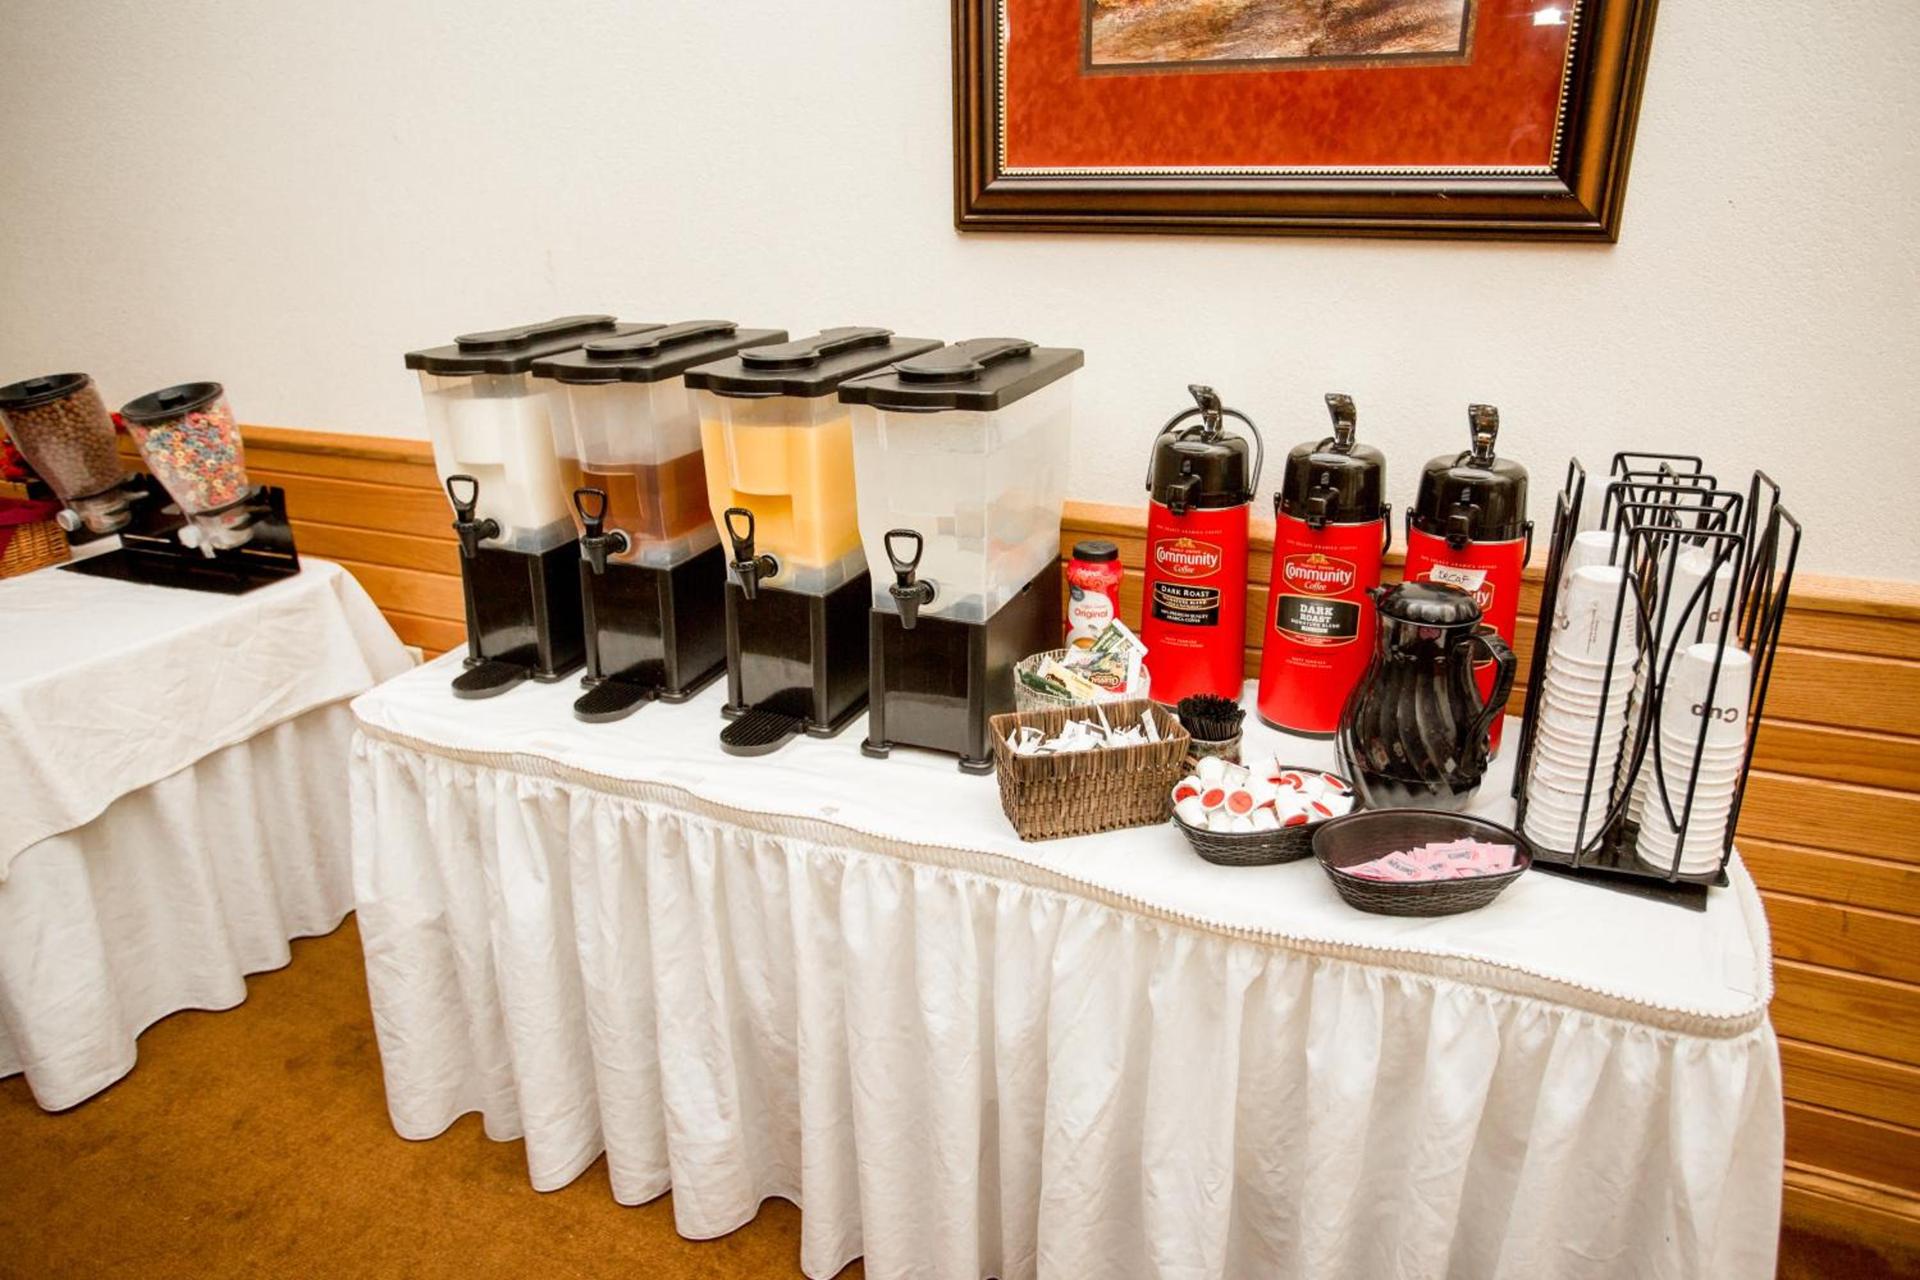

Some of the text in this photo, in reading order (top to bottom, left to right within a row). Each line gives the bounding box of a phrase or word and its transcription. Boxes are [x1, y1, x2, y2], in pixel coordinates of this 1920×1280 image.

[1156, 546, 1218, 568] Community
[1173, 564, 1195, 574] Coffee
[1285, 561, 1352, 585] Community
[1161, 585, 1210, 598] DARK ROAST
[1304, 581, 1327, 591] Coffee
[1074, 608, 1108, 619] Original
[1300, 604, 1334, 616] DARK
[1300, 613, 1332, 623] ROAST
[1690, 702, 1739, 723] Cup
